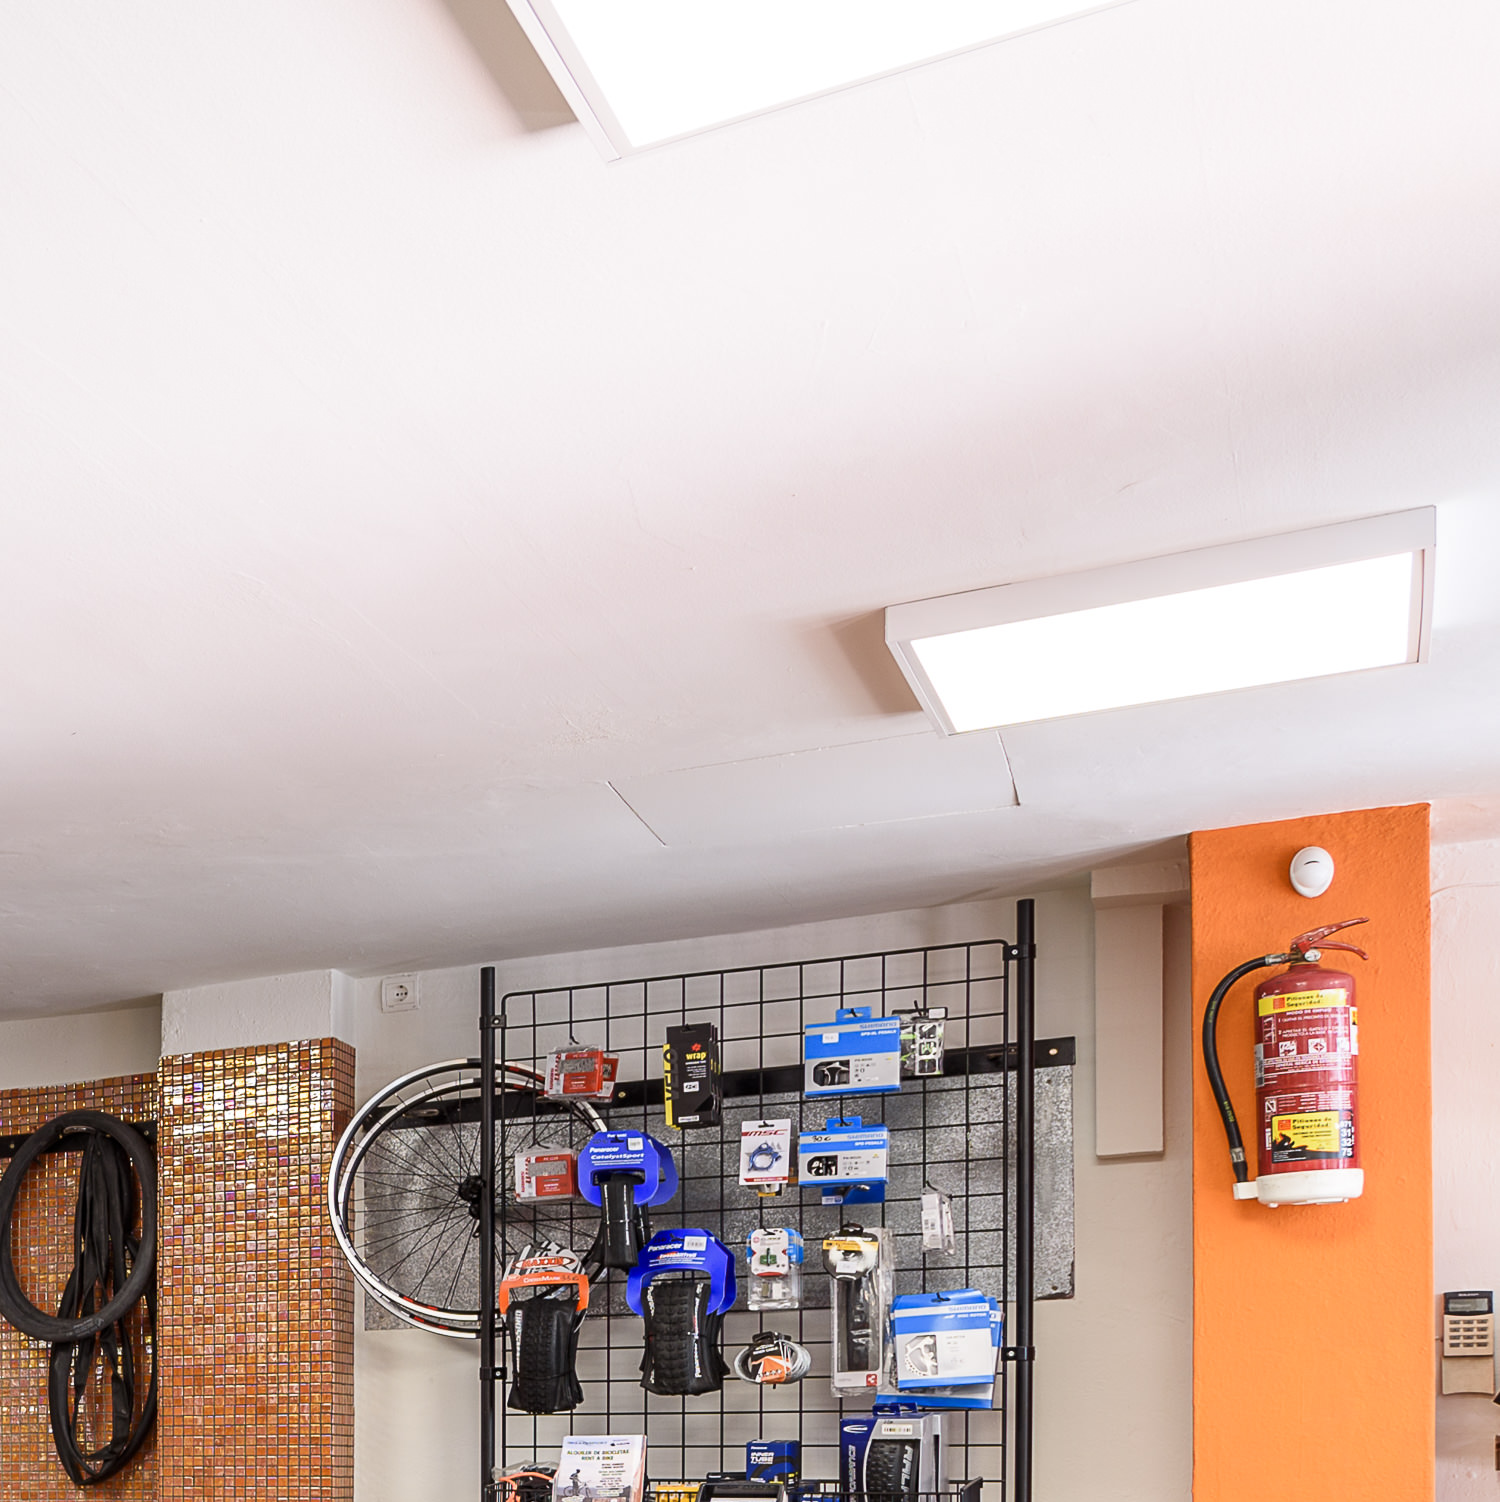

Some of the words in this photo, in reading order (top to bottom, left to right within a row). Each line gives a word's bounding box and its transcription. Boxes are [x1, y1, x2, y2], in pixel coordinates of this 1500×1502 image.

[859, 1021, 897, 1029] SHIMANO
[686, 1052, 707, 1061] wrap
[1342, 1148, 1352, 1156] 75
[648, 1243, 682, 1252] Panaracer
[948, 1304, 987, 1312] SHIMANO
[751, 1456, 774, 1464] TUBE
